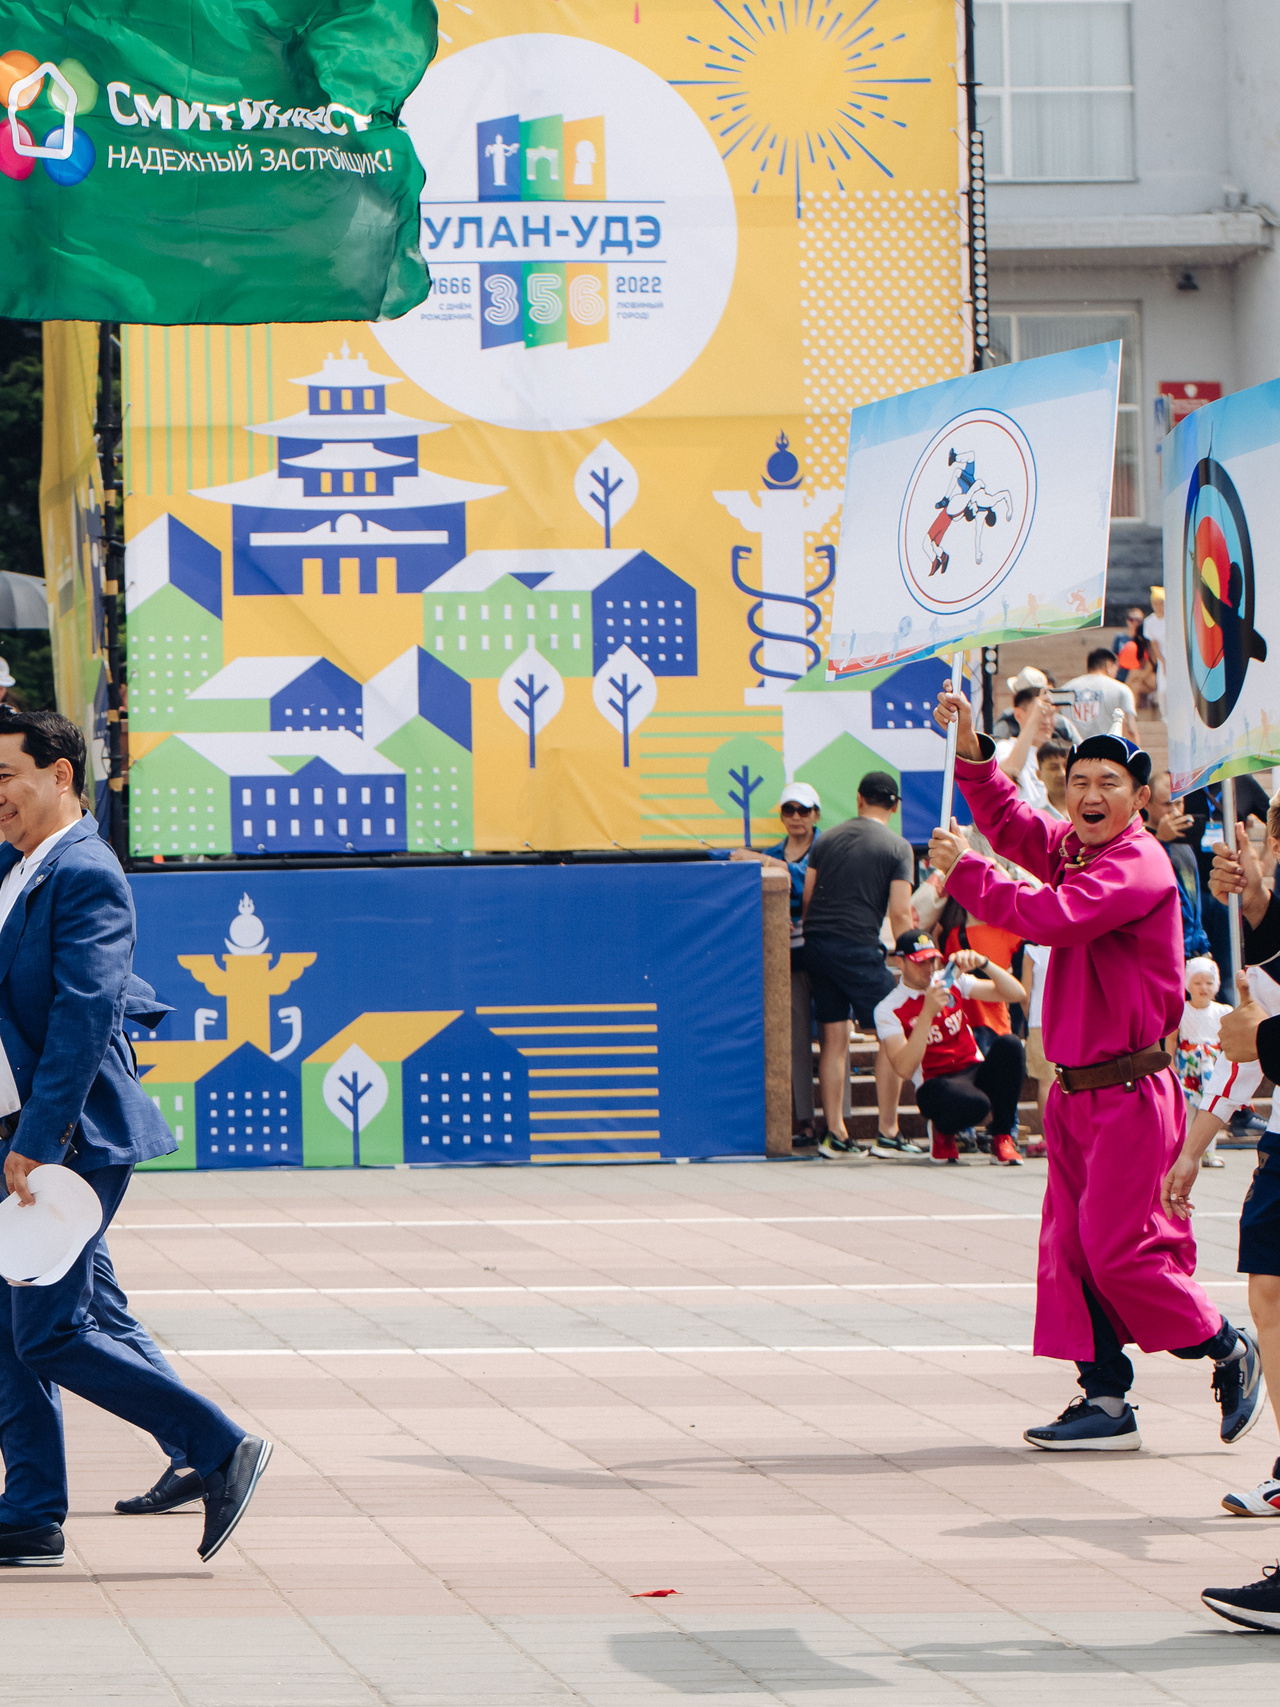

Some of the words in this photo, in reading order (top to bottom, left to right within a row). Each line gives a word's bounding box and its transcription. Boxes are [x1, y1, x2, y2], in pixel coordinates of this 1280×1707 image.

[107, 144, 253, 175] НАДЕЖНЫЙ
[423, 215, 661, 256] УЛАН-УДЭ
[432, 277, 472, 295] 1666
[616, 276, 662, 293] 2022
[484, 273, 606, 325] 356
[1073, 702, 1100, 722] NFL
